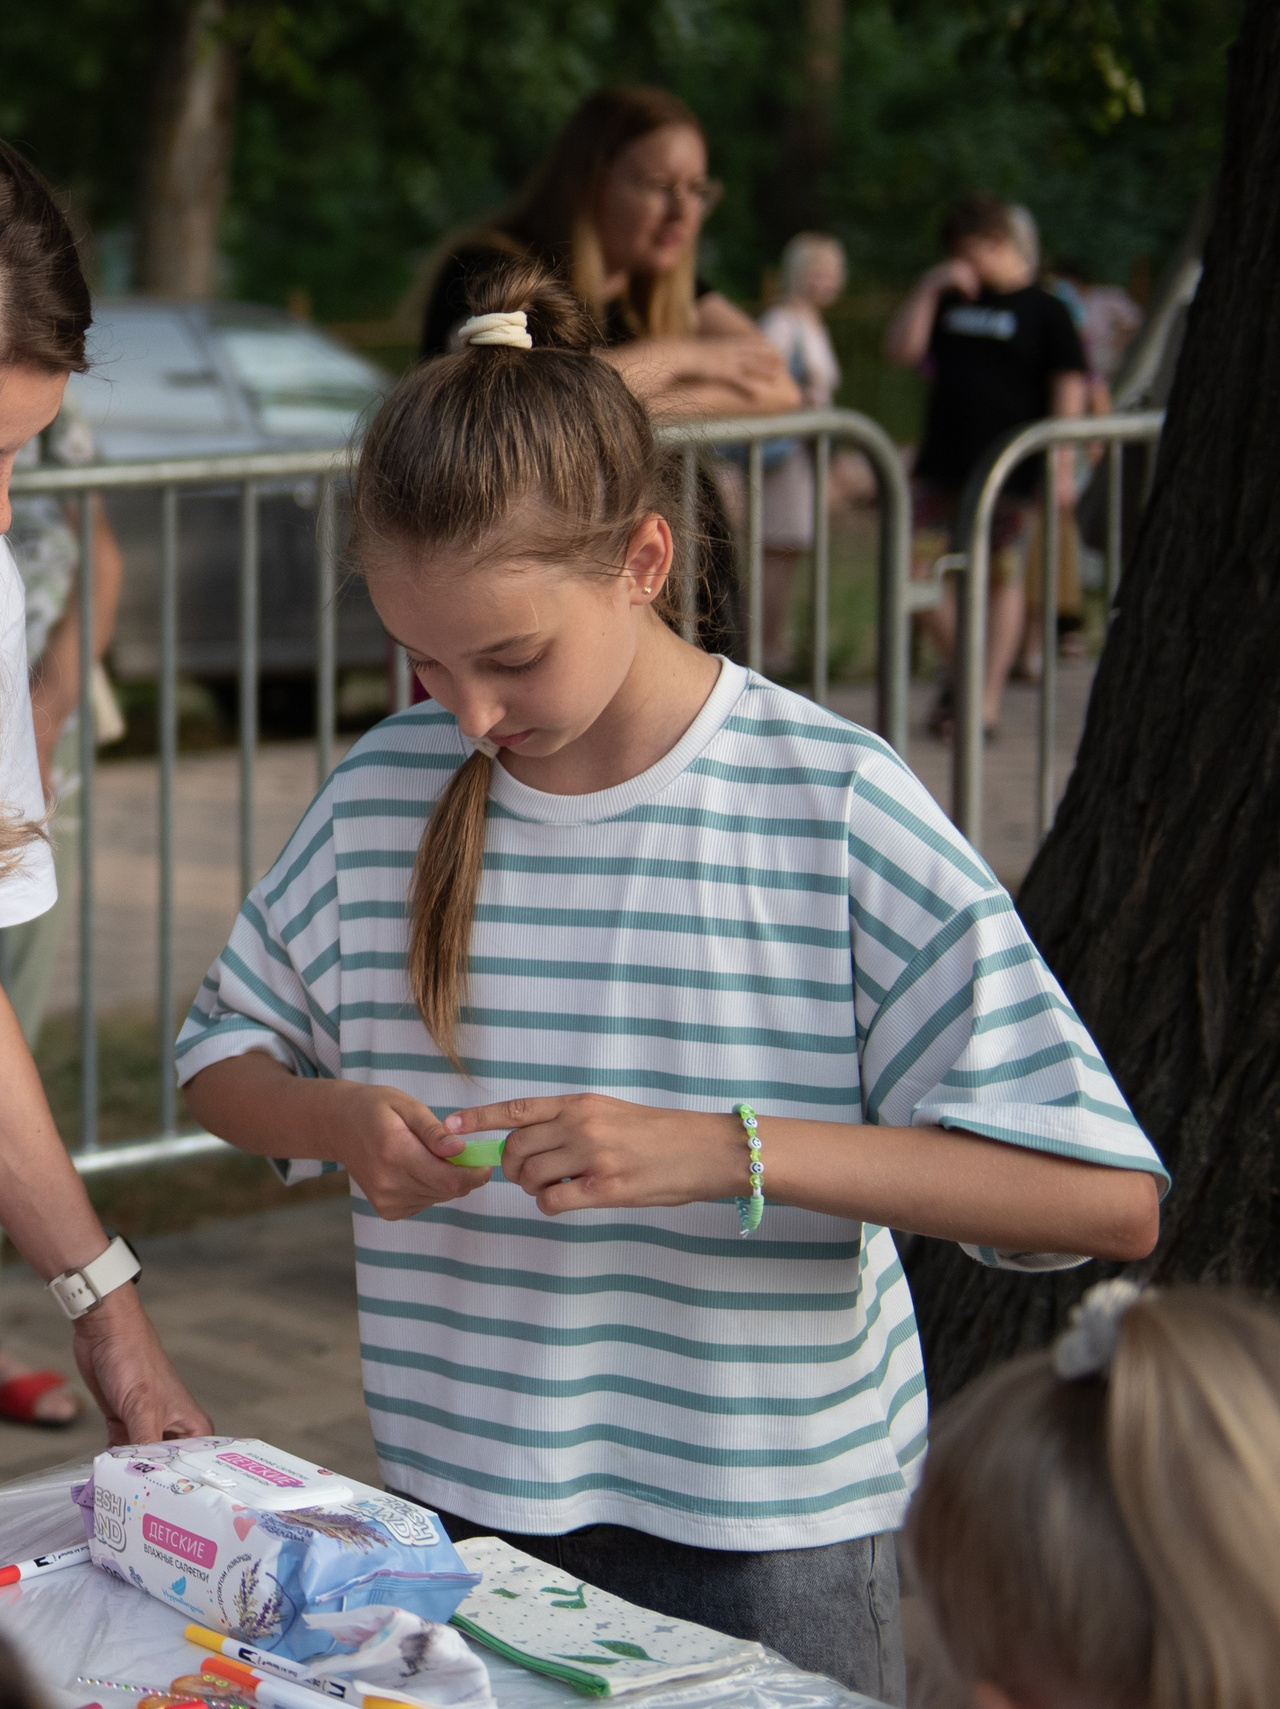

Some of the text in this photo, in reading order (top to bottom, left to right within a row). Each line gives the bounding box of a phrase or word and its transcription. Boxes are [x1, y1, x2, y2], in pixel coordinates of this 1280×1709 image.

[218, 1453, 297, 1486] ДЕТСКИЕ
[94, 1486, 122, 1517] ESH
[148, 1521, 206, 1559] ДЕТСКИЕ
[143, 1543, 210, 1583] ВЛАЖНЫЕ САЛФЕТКИ
